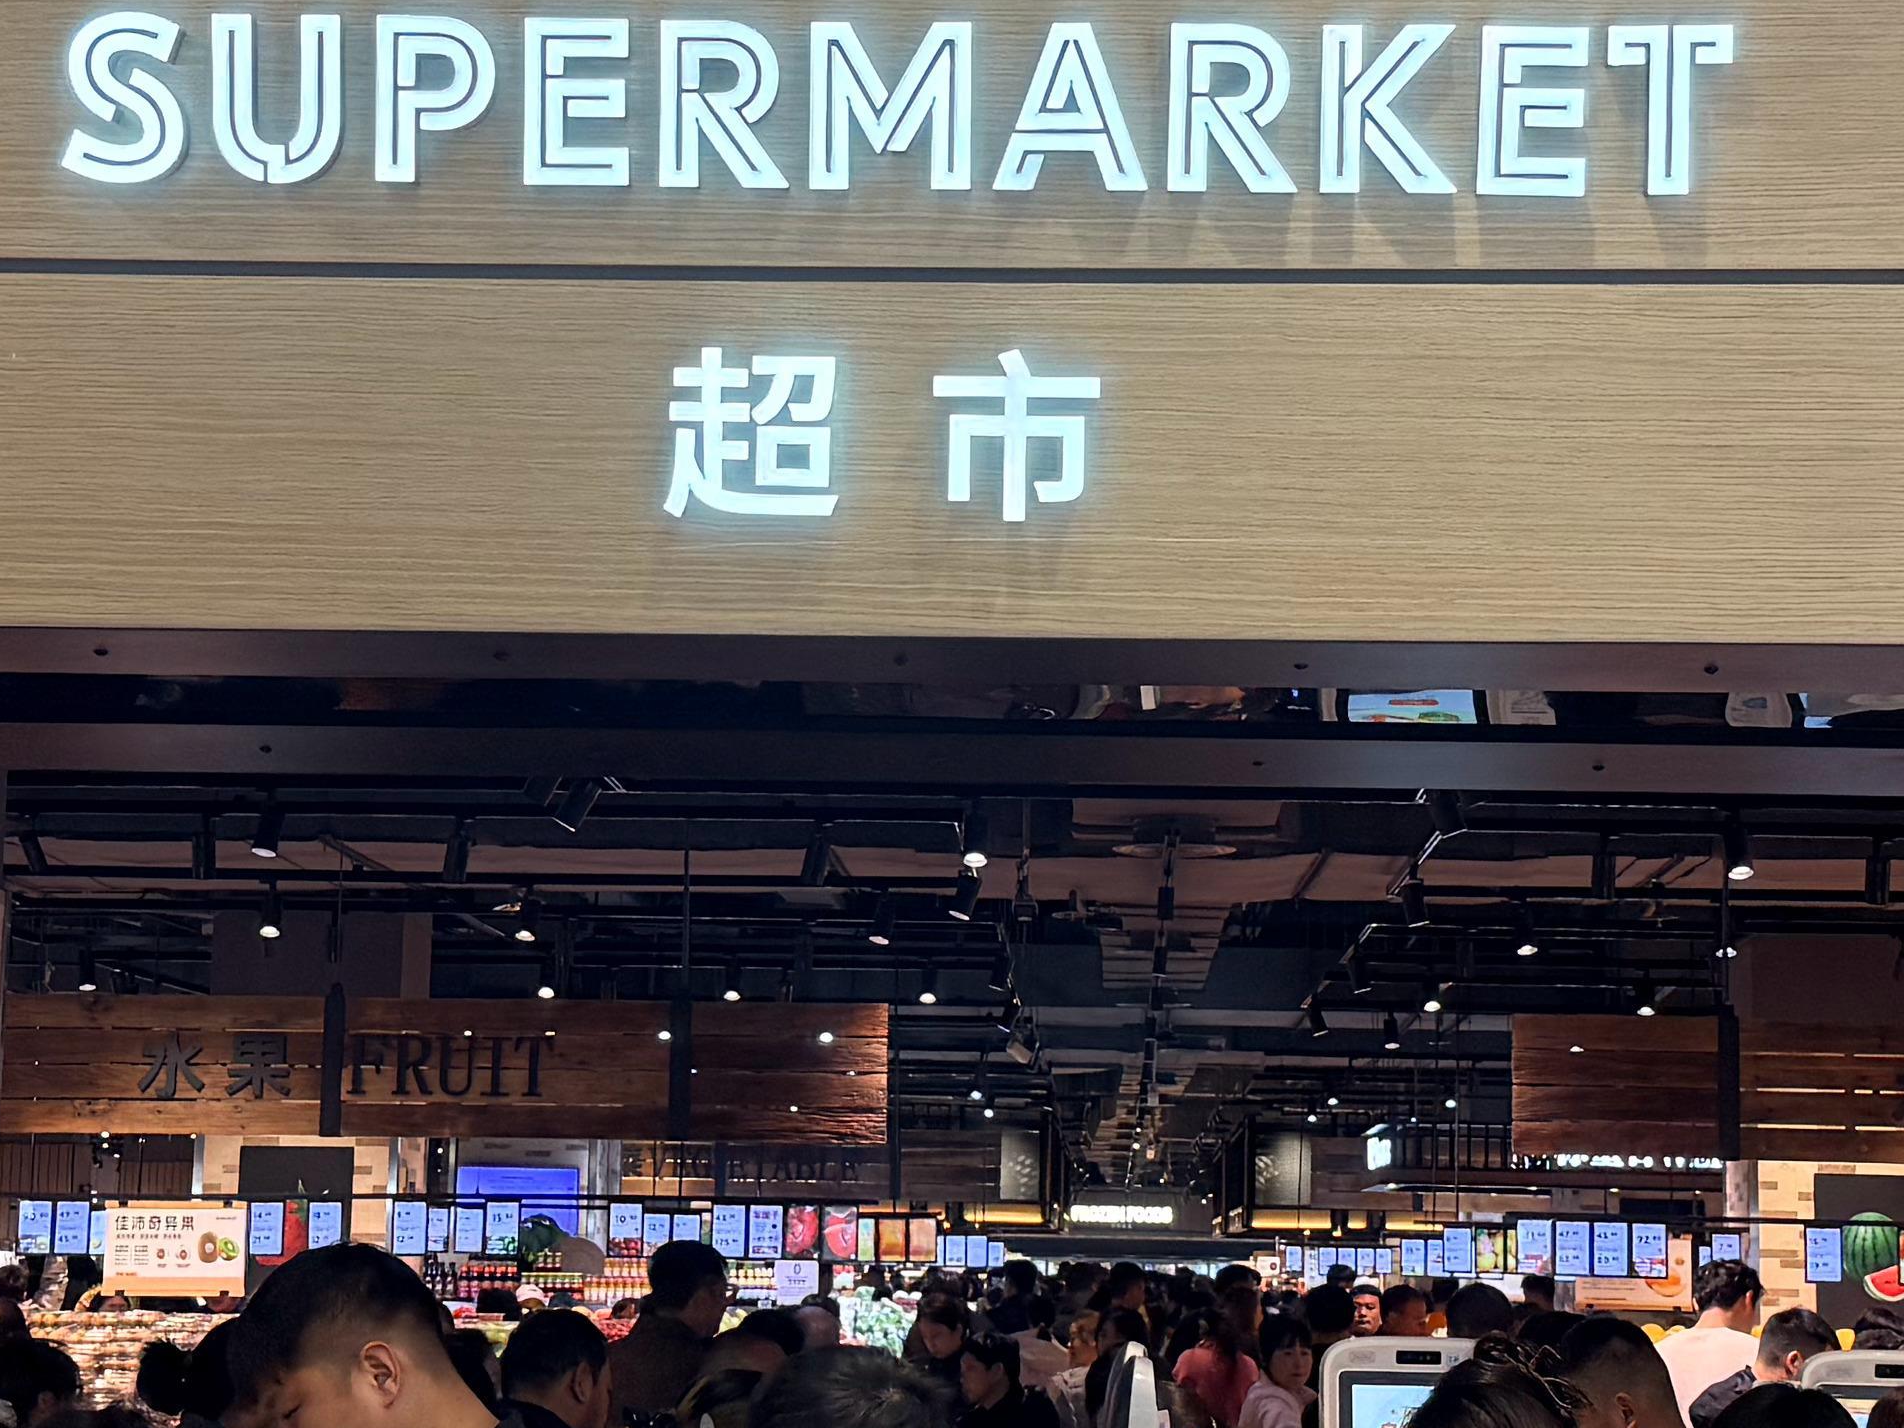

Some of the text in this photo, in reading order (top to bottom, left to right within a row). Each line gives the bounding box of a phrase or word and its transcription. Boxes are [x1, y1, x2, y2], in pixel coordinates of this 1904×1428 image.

[61, 10, 1737, 199] SUPERMARKET
[661, 346, 1101, 524] 超市
[136, 1031, 292, 1100] 水果
[346, 1033, 554, 1098] FRUIT
